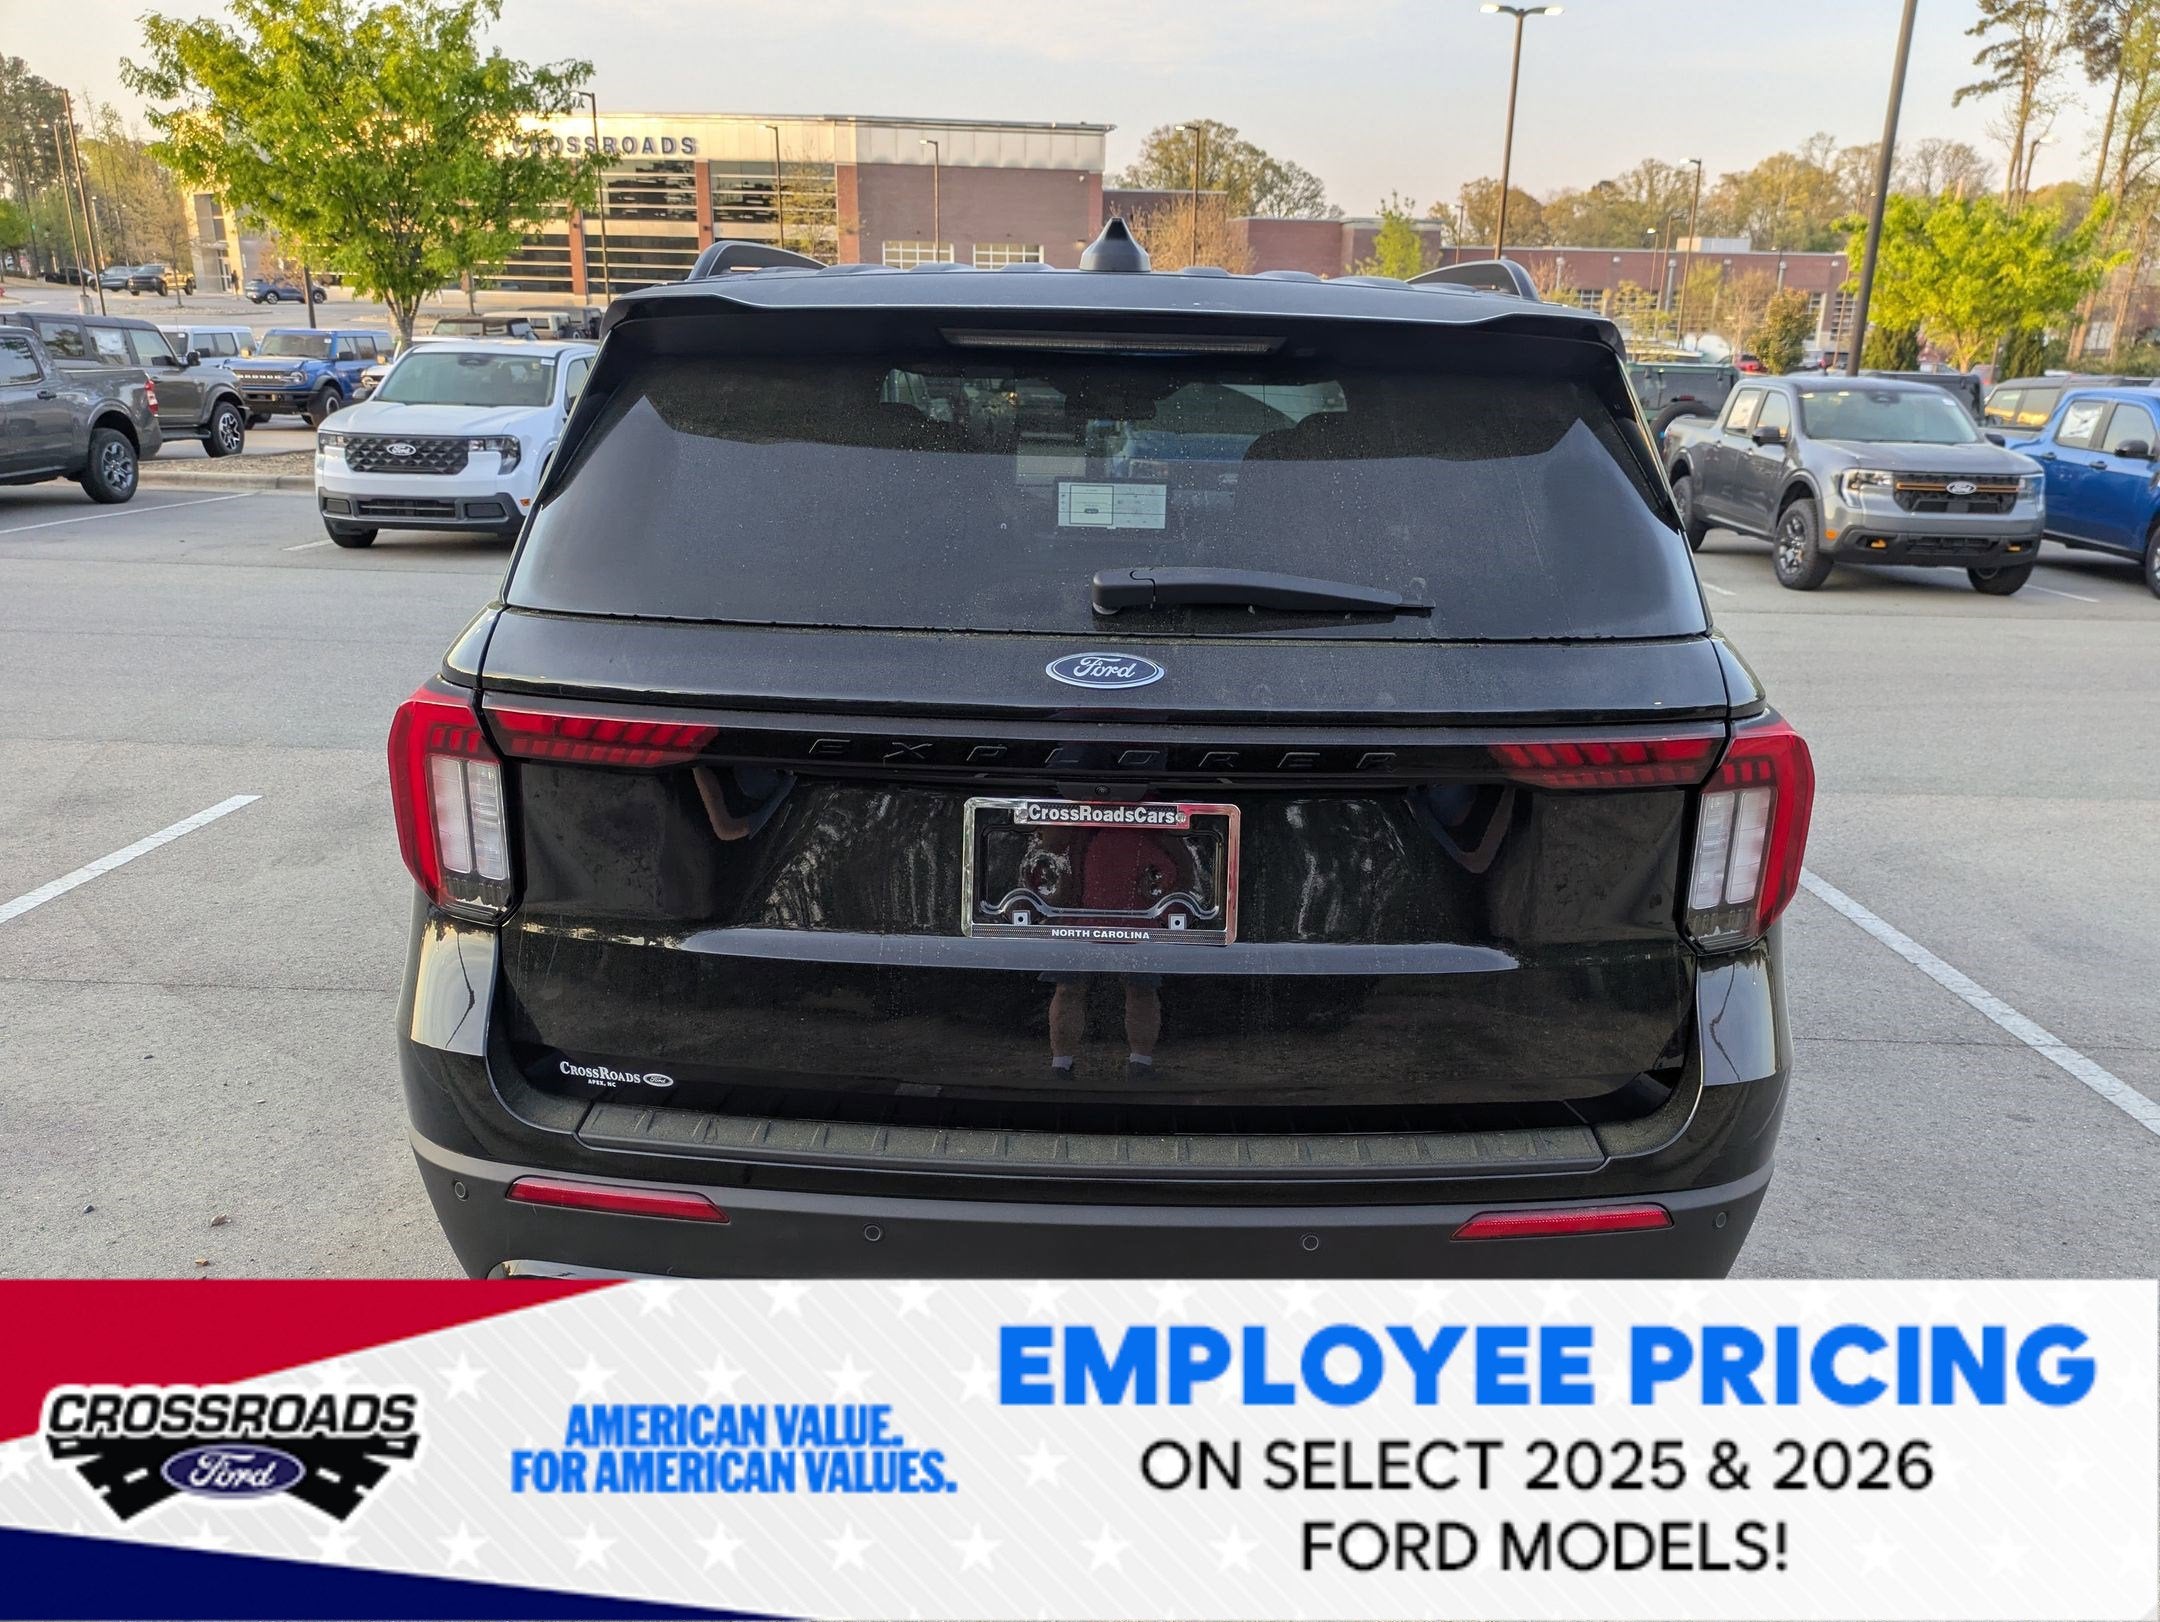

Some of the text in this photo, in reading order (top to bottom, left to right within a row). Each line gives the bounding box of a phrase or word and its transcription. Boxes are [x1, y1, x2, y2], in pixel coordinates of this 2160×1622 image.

[1073, 656, 1137, 678] Ford
[808, 738, 1397, 770] EXPLORER
[1028, 804, 1177, 824] CrossRoadsCars
[1051, 928, 1150, 940] NORTH CAROLINA
